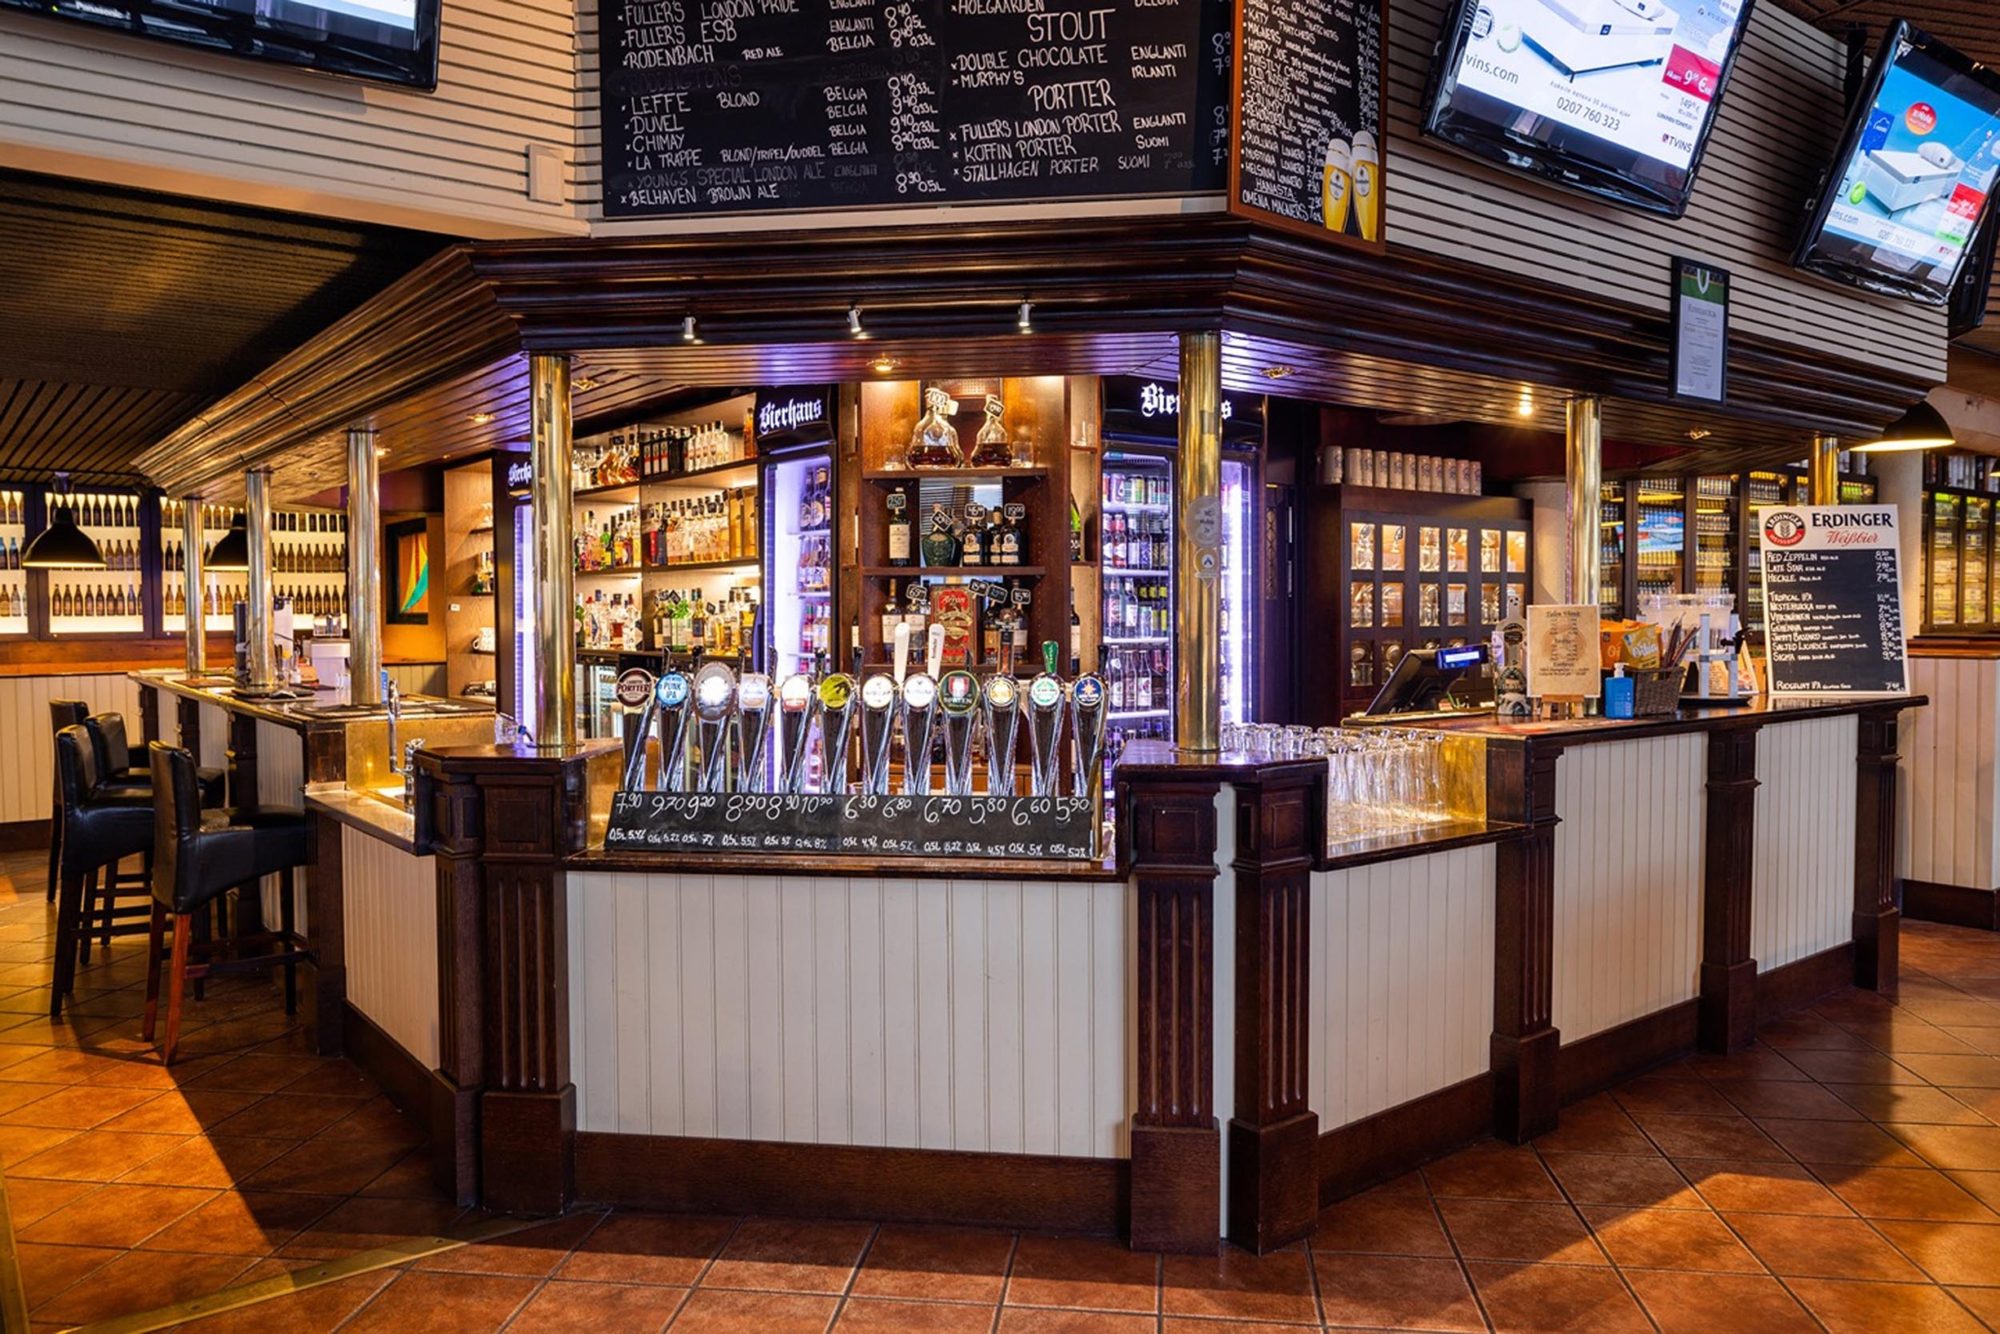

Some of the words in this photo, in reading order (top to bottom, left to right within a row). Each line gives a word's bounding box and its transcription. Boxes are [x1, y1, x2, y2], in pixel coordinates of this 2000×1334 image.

[700, 0, 755, 20] LONDON
[624, 25, 686, 48] FULLER'S
[701, 18, 737, 42] ESB
[829, 17, 875, 33] ENGLANTI
[1027, 8, 1116, 42] STOUT
[624, 44, 715, 69] RODENBACH
[741, 47, 764, 60] RED
[766, 46, 784, 58] ALE
[826, 34, 876, 52] BELGIA
[956, 51, 1009, 71] DOUBLE
[1017, 44, 1109, 70] CHOCOLATE
[1131, 44, 1187, 60] ENGLANTI
[960, 70, 1025, 88] MURPHY'S
[1131, 64, 1177, 79] IRLANTI
[631, 92, 692, 115] LEFFE
[716, 91, 760, 109] BLOND
[823, 86, 868, 102] BELGIA
[1028, 78, 1117, 112] PORTTER
[630, 113, 685, 135] DUVEL
[825, 103, 868, 119] BELGIA
[1015, 115, 1060, 139] LONDON
[1062, 110, 1123, 135] PORTER
[1133, 112, 1187, 129] ENGLANTI
[1557, 96, 1583, 115] 0207
[1583, 106, 1602, 124] 760
[1602, 114, 1621, 131] 323
[632, 133, 685, 153] CHIMAY
[828, 124, 867, 137] BELGIA
[1016, 134, 1077, 159] PORTER
[1136, 134, 1170, 149] SUOMI
[636, 155, 652, 171] LA
[658, 148, 703, 169] TRAPPE
[828, 141, 869, 157] BELGIA
[962, 160, 1040, 182] STALLHAGEN
[1049, 156, 1099, 176] PORTER
[1118, 154, 1151, 170] SUOMI
[696, 163, 751, 187] SPECIAL
[755, 164, 798, 183] LONDON
[803, 161, 825, 179] ALE
[628, 185, 697, 206] BELHAVEN
[707, 184, 751, 204] BROWN
[757, 182, 780, 199] ALE
[759, 398, 822, 435] Bierhaus
[1812, 513, 1894, 528] ERDINGER
[1766, 551, 1782, 562] RED
